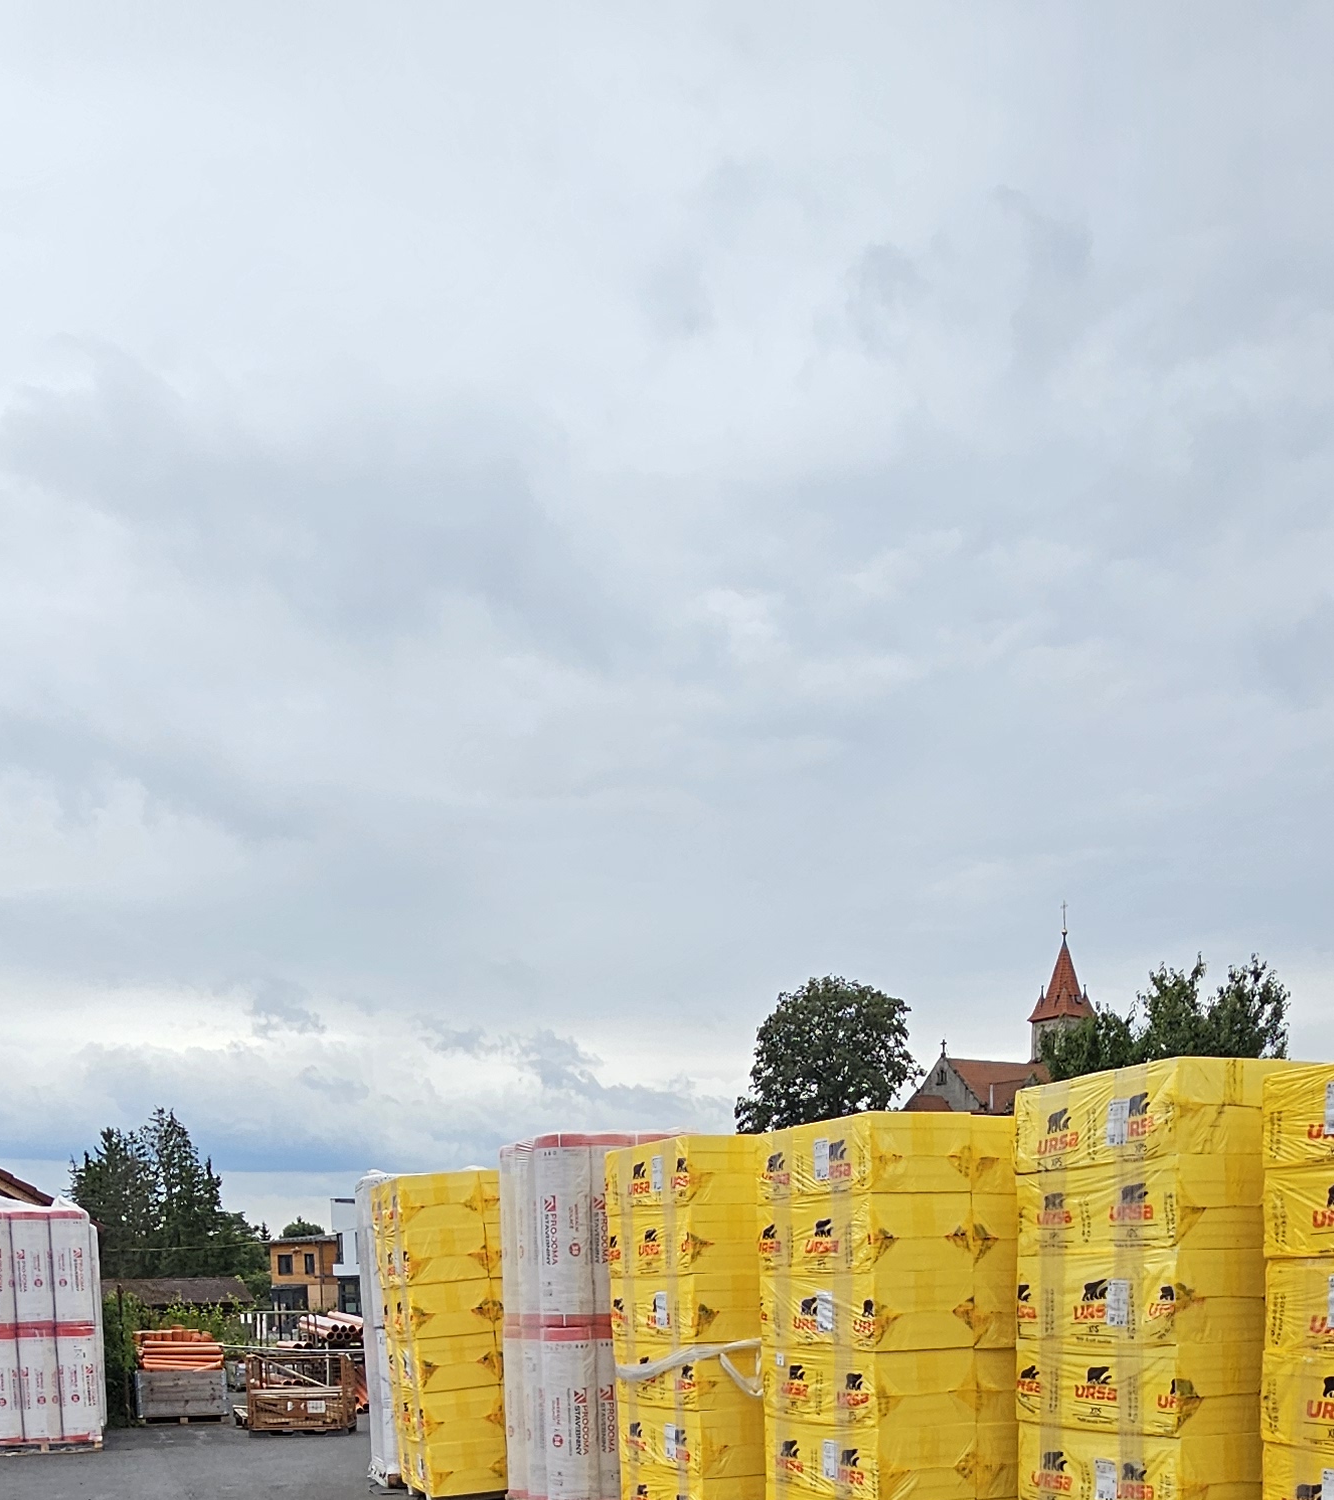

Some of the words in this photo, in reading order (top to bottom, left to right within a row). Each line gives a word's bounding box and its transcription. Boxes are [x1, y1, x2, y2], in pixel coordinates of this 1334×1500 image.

[1127, 1114, 1155, 1137] RSA
[1037, 1131, 1079, 1156] URSA
[1109, 1205, 1154, 1222] URSA
[1073, 1304, 1107, 1320] URS
